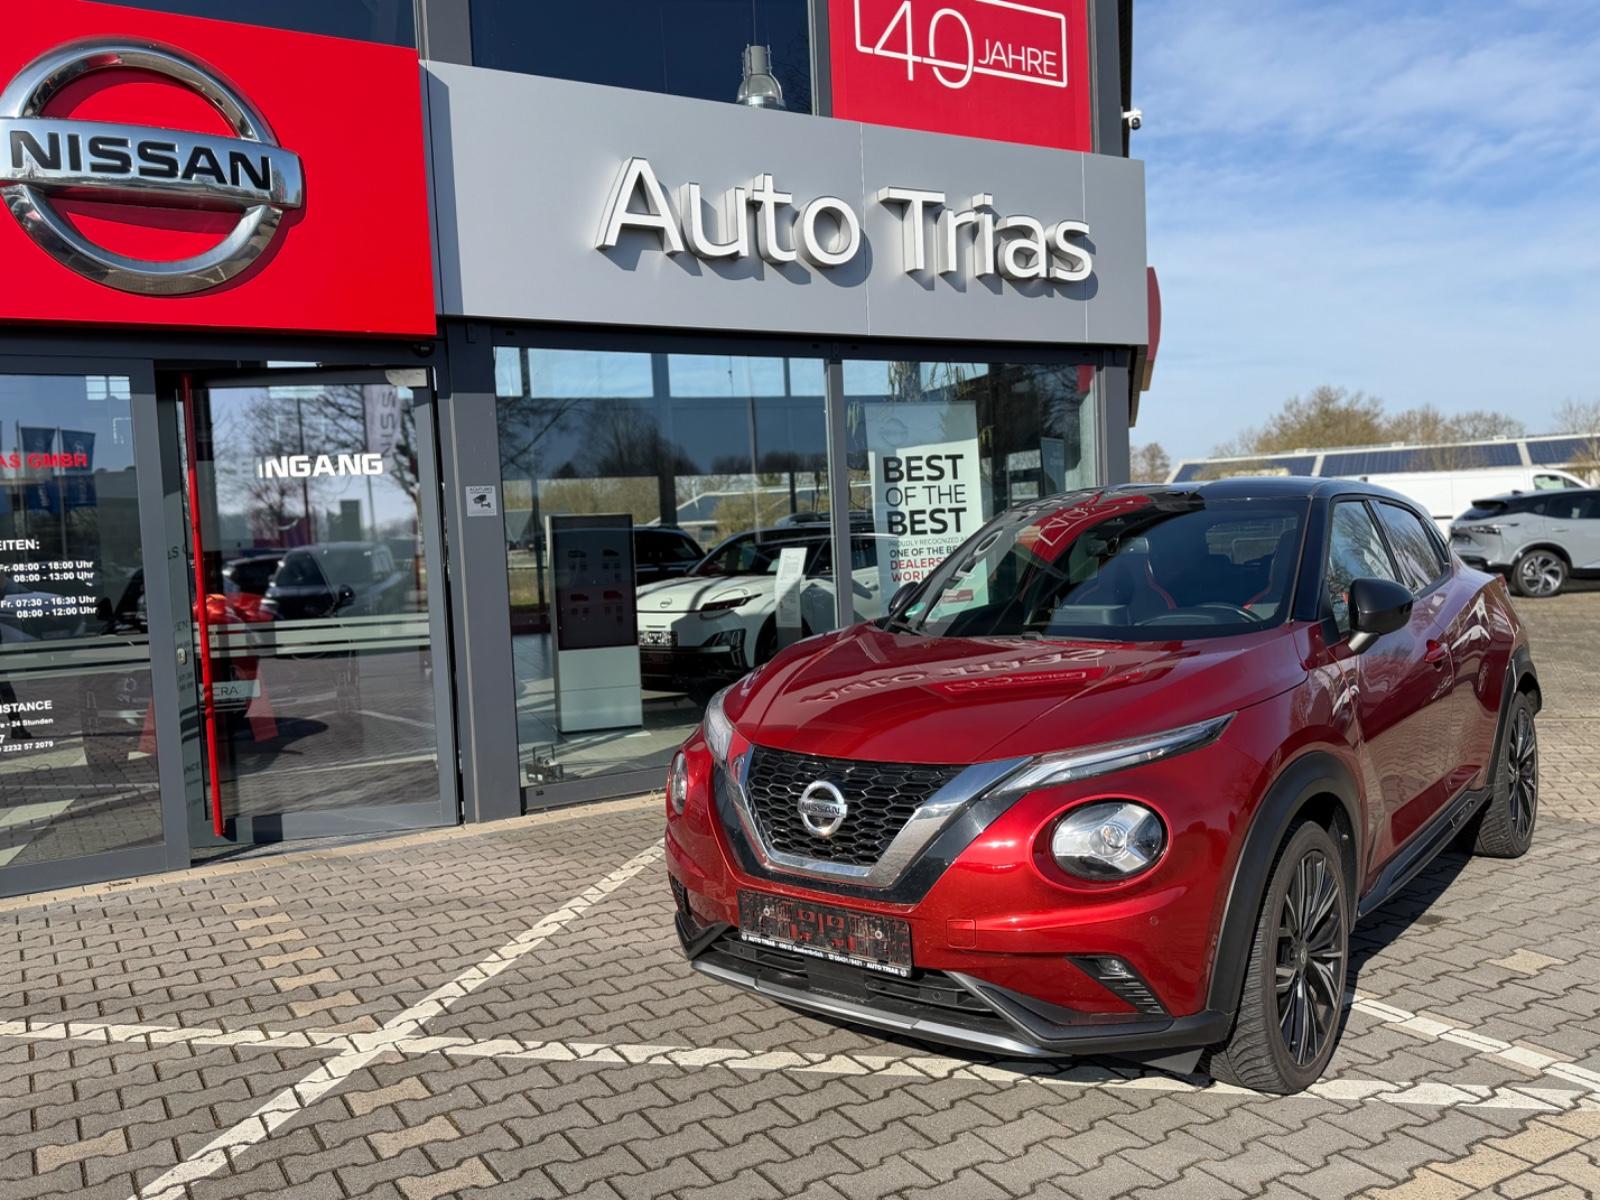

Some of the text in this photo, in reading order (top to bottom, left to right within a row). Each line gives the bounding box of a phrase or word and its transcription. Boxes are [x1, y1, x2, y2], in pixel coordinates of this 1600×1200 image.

[872, 0, 1058, 90] 40 JAHRE
[9, 130, 272, 190] NISSAN
[596, 156, 1094, 283] Auto Trias
[26, 452, 89, 468] GMBH
[883, 453, 965, 484] BEST
[885, 484, 967, 508] OF THE
[886, 506, 968, 537] BEST
[919, 536, 960, 546] RECOGNIZED
[889, 548, 910, 558] ONE
[911, 547, 924, 557] OF
[926, 546, 945, 556] THE
[12, 562, 39, 572] 08:00
[48, 560, 74, 570] 18:00
[76, 560, 94, 569] Uhr
[13, 573, 40, 583] 08:00
[48, 571, 75, 581] 13:00
[76, 571, 95, 580] Uhr
[16, 598, 42, 608] 07:30
[51, 596, 77, 606] 16:30
[79, 595, 96, 604] Uhr
[16, 609, 43, 619] 08:00
[52, 606, 77, 616] 12:00
[79, 606, 98, 615] Uhr
[11, 720, 21, 728] 24
[22, 718, 54, 727] Stunden
[3, 743, 22, 752] 2232
[23, 742, 33, 750] 57
[35, 740, 54, 749] 2079
[800, 801, 840, 816] NISSAN
